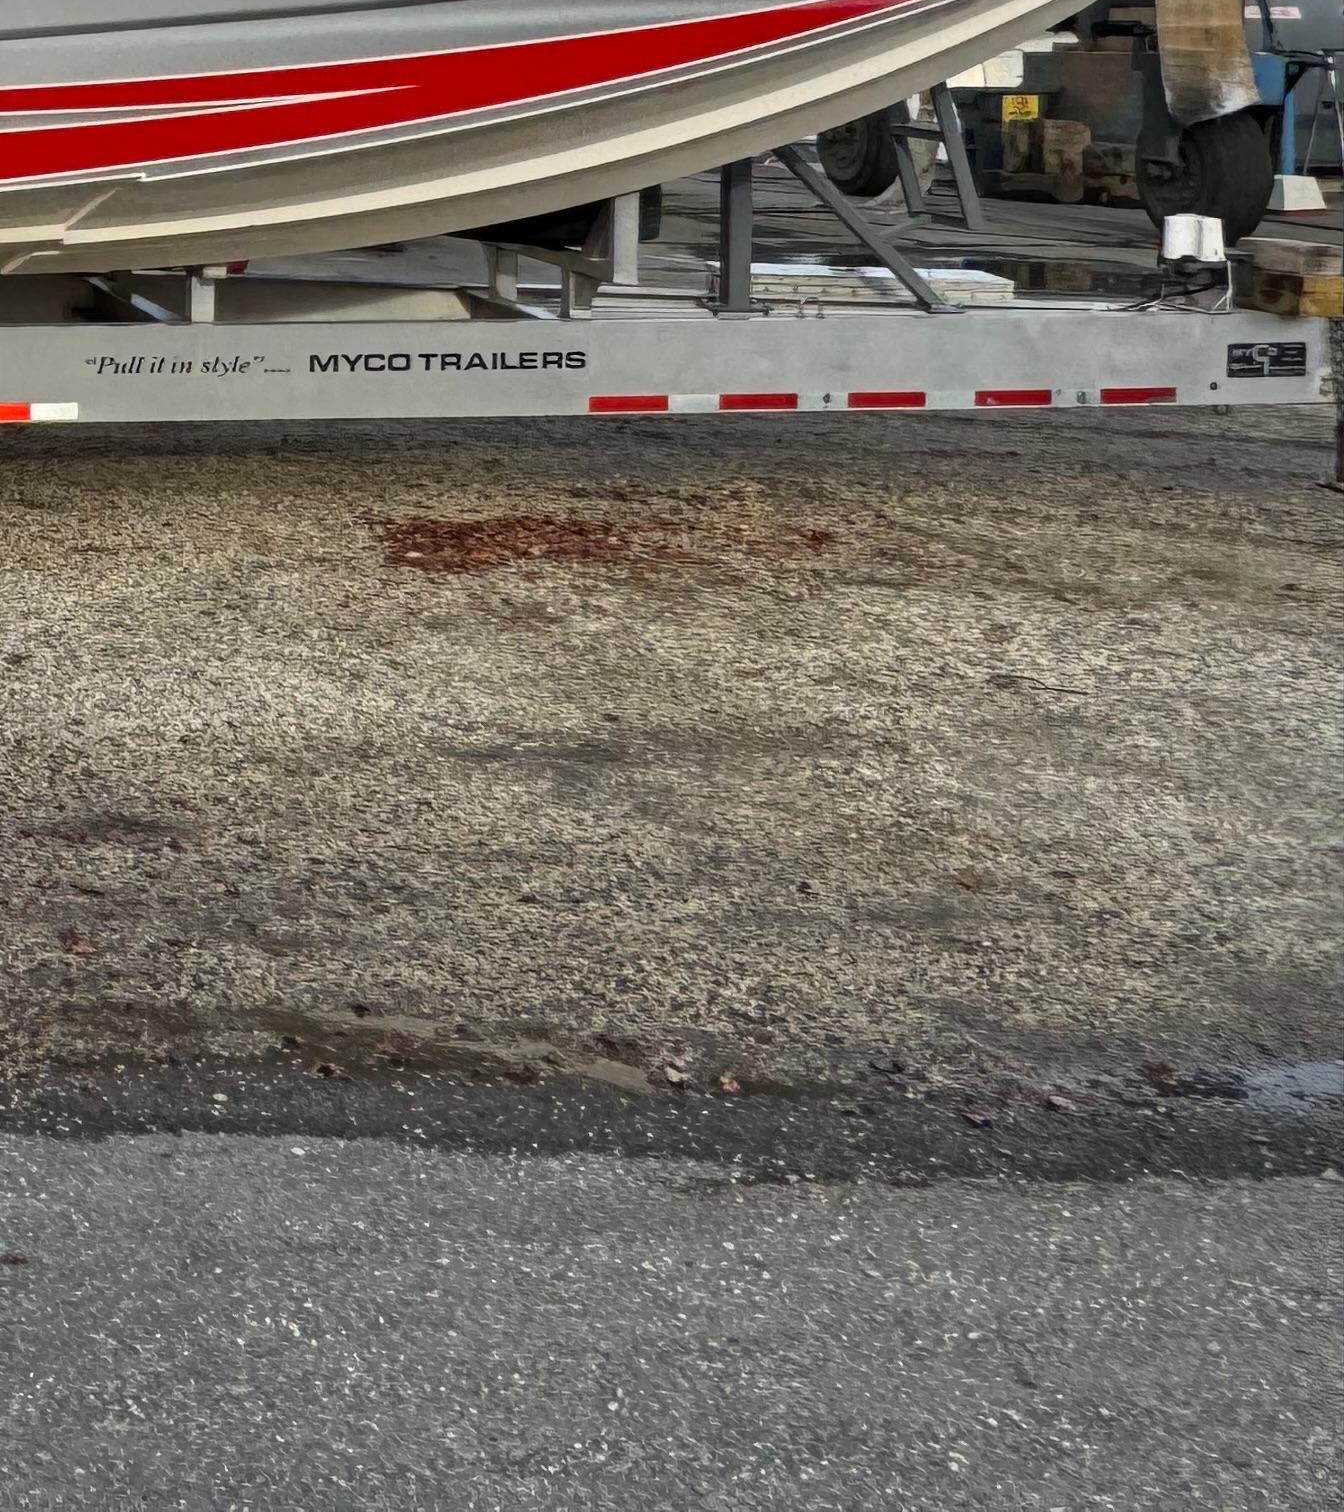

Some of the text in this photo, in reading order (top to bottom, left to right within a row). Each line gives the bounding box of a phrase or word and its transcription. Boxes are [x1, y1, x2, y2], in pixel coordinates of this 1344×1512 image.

[150, 356, 165, 374] it
[171, 356, 193, 374] in
[309, 353, 411, 373] MYCO
[418, 351, 586, 371] TRAILERS
